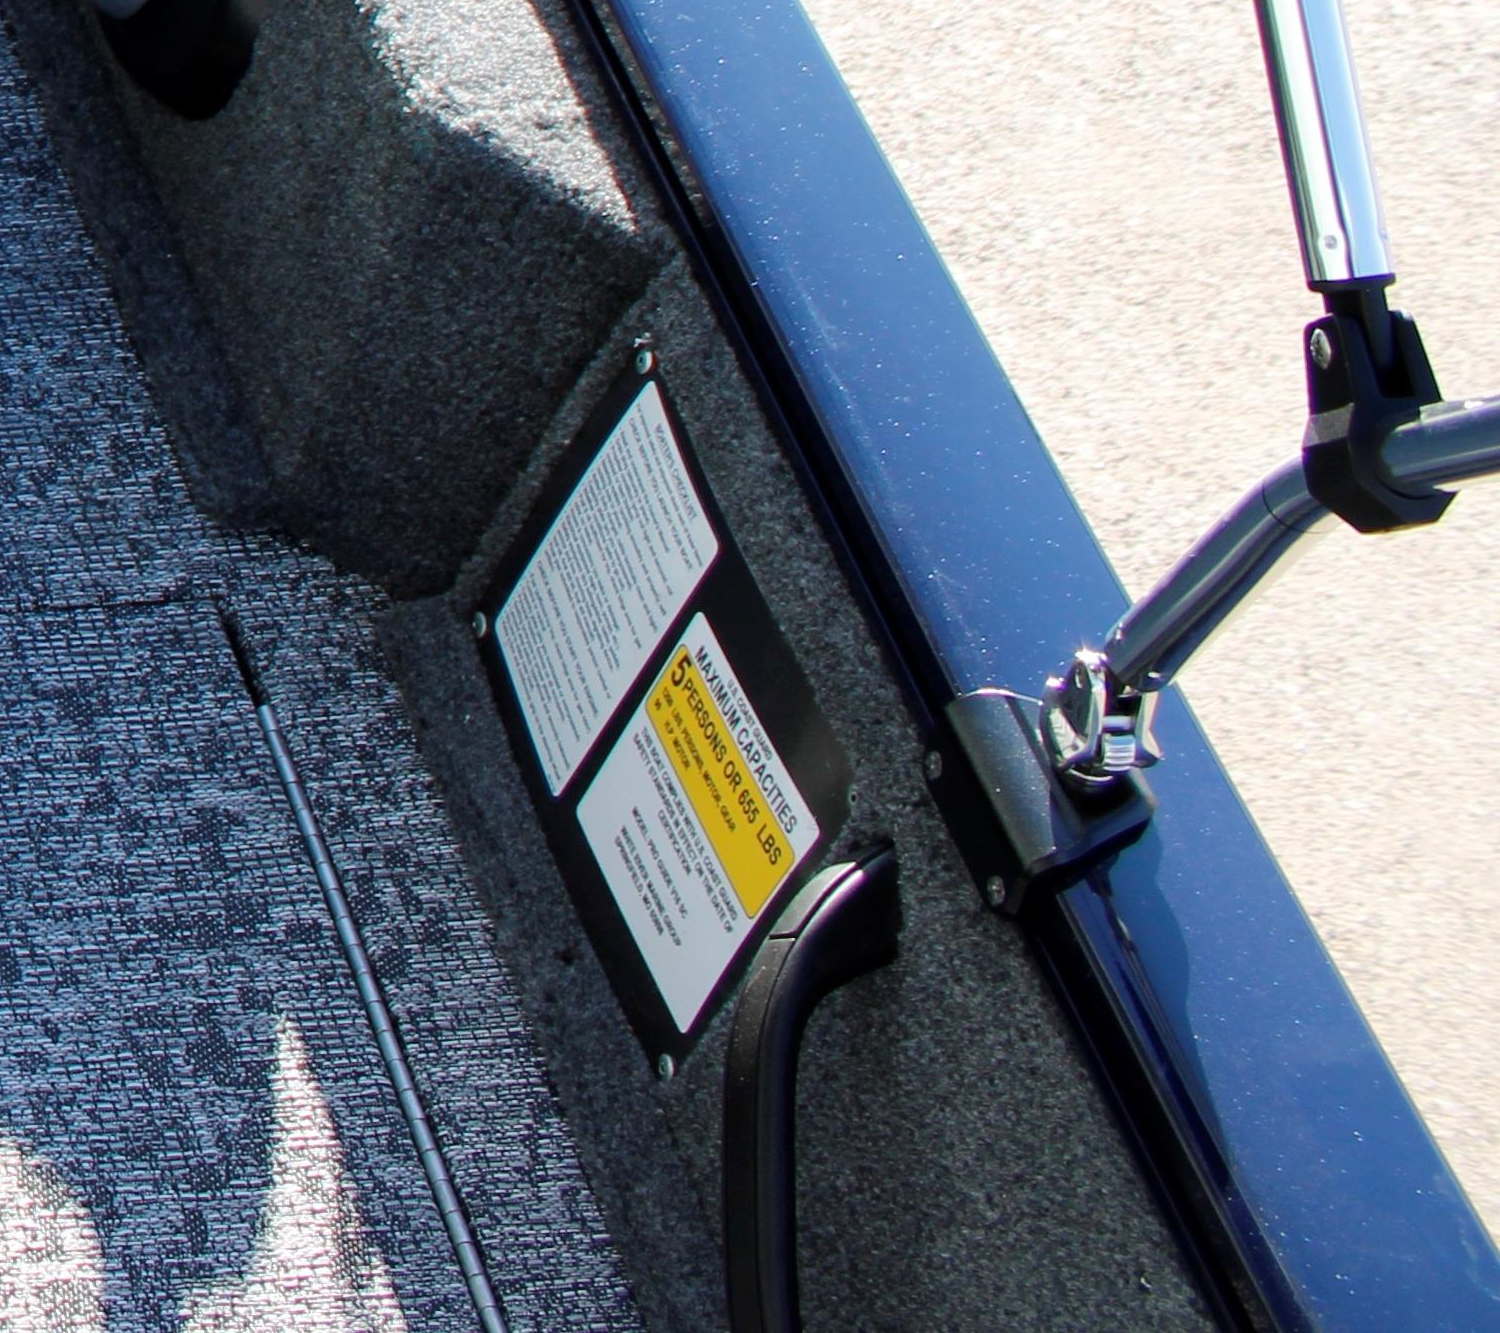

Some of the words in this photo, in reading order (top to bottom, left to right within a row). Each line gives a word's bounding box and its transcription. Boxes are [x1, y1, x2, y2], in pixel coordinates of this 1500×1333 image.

[672, 469, 697, 519] CHECKLIST
[673, 738, 689, 768] MOTOR
[696, 647, 740, 729] MAXIMUM
[738, 729, 796, 833] CAPACITIES
[727, 680, 738, 698] U.S.
[737, 698, 755, 726] COAST
[753, 728, 772, 760] GUARD
[671, 655, 692, 687] 5
[683, 679, 726, 762] PERSONS
[724, 761, 742, 792] OR
[738, 789, 759, 823] 655
[757, 824, 781, 865] LBS
[634, 733, 650, 765] SAFETY
[649, 767, 675, 818] STANDARDS
[674, 819, 680, 828] IN
[678, 828, 697, 861] EFFECT
[696, 862, 704, 877] ON
[704, 876, 713, 895] THE
[711, 895, 725, 919] DATE
[725, 920, 733, 933] OF
[642, 727, 653, 748] THIS
[650, 747, 664, 770] BOAT
[663, 772, 685, 815] COMPLIES
[684, 816, 696, 837] WITH
[704, 856, 721, 886] COAST
[720, 887, 737, 920] GUARD
[659, 810, 691, 874] CERTIFICATION
[721, 806, 735, 831] GEAR
[621, 827, 635, 853] WHITE
[634, 854, 648, 880] RIVER
[647, 881, 664, 913] MARINE
[664, 915, 681, 946] GROUP
[643, 895, 650, 909] MO
[648, 839, 659, 860] PRO
[658, 860, 672, 887] GUIDE
[679, 904, 687, 918] SC
